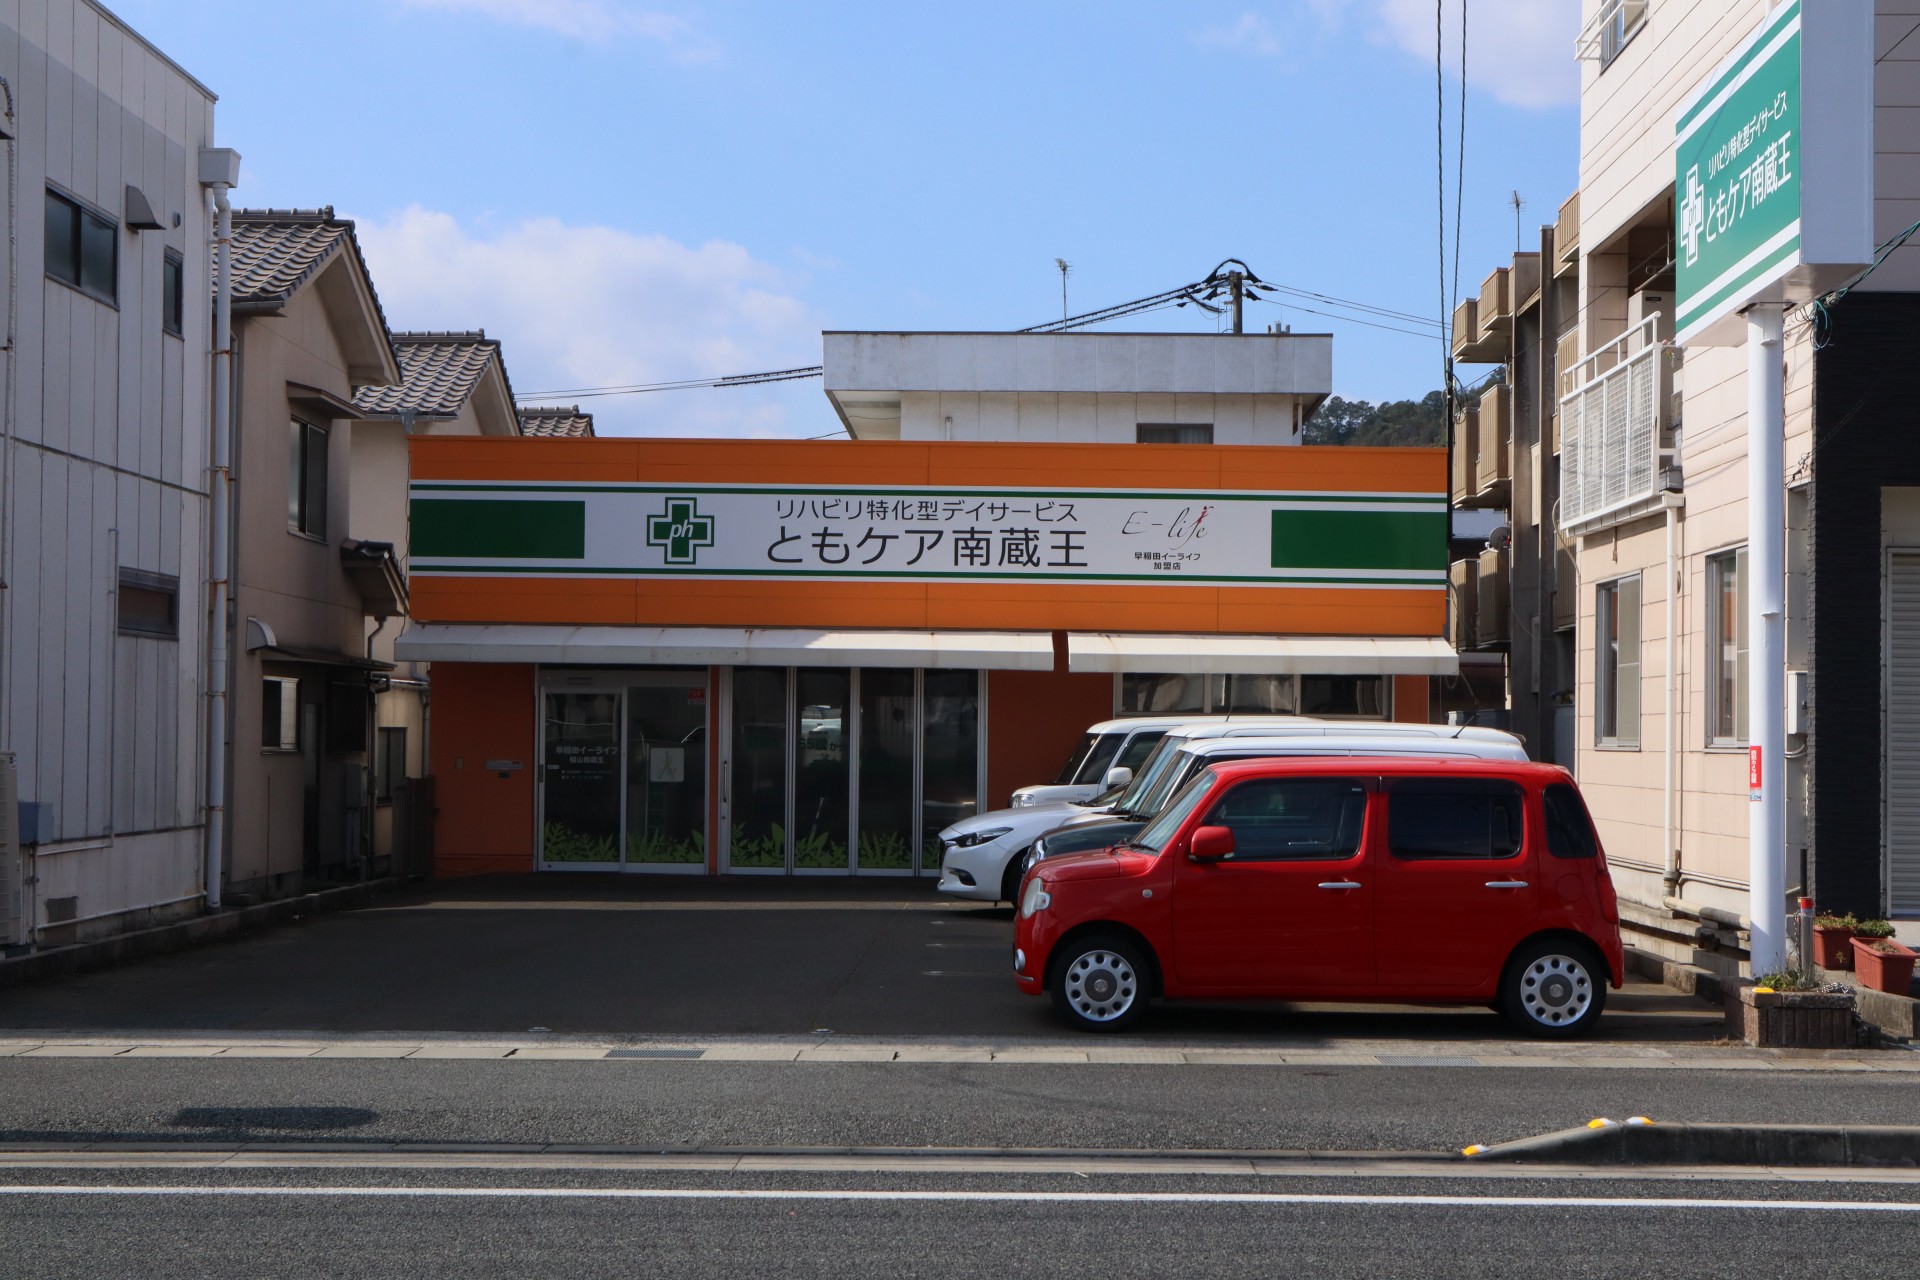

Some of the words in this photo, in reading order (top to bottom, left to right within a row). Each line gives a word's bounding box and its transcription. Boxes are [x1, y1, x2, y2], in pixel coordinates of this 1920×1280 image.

[1708, 91, 1787, 180] リハビリ特化型デイサービス
[1706, 131, 1792, 243] ともケア南蔵王
[777, 498, 1078, 522] リハビリ特化型デイサービス
[669, 519, 694, 541] ph
[767, 526, 1088, 567] ともケア南蔵王
[1134, 552, 1201, 561] 早稲田イーライフ
[1153, 561, 1181, 570] 加盟店
